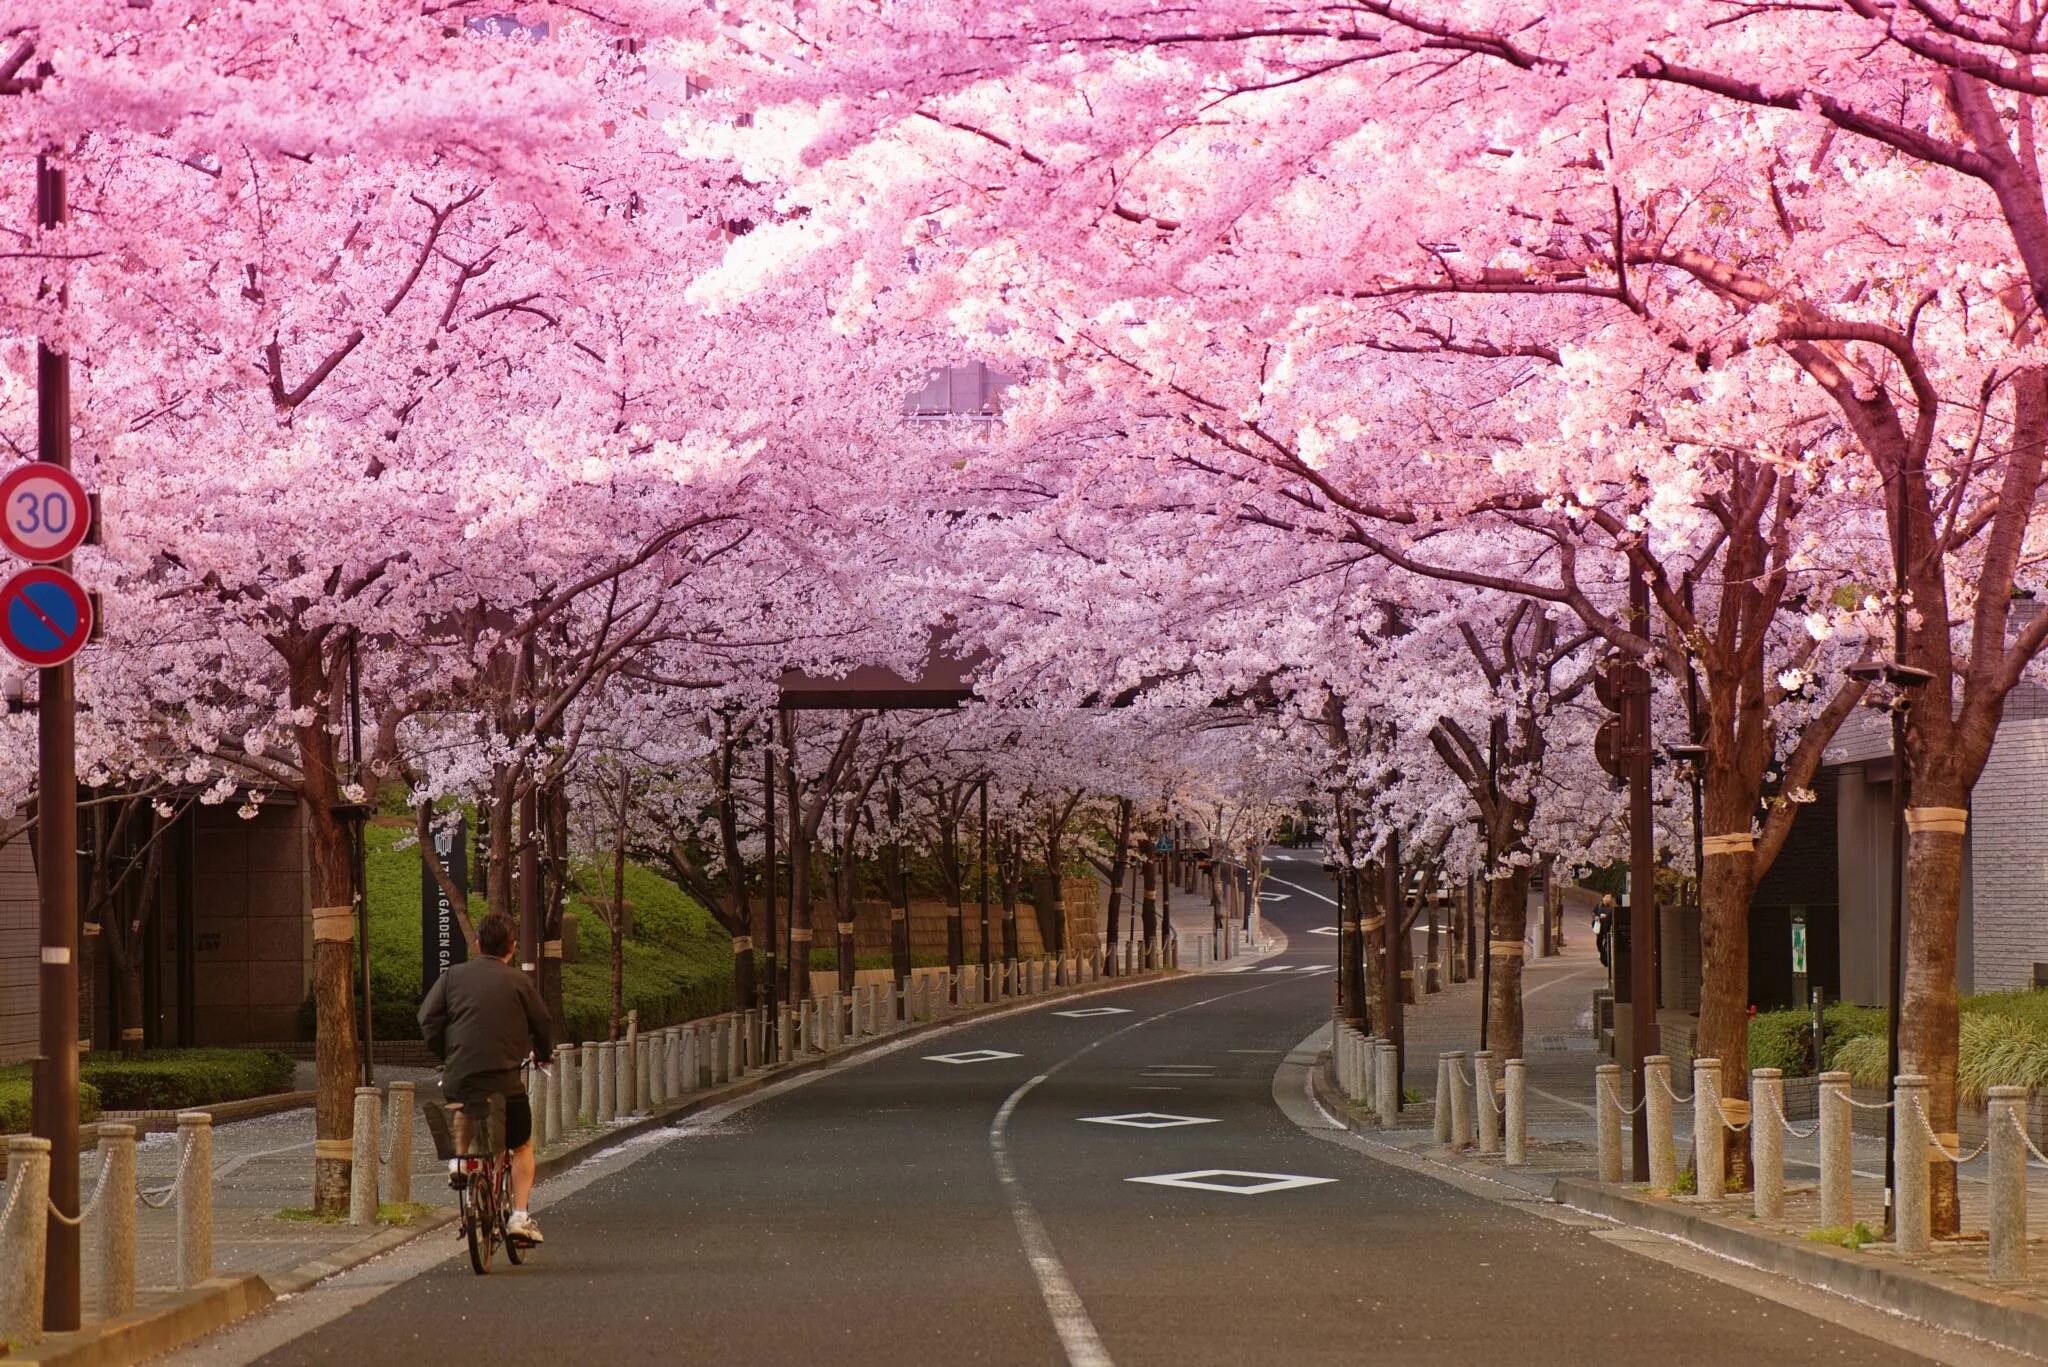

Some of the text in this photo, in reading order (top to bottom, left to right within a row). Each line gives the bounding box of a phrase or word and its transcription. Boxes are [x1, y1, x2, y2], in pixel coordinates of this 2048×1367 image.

[16, 492, 67, 533] 30
[439, 899, 450, 947] GARDEN
[440, 950, 450, 976] GAL
